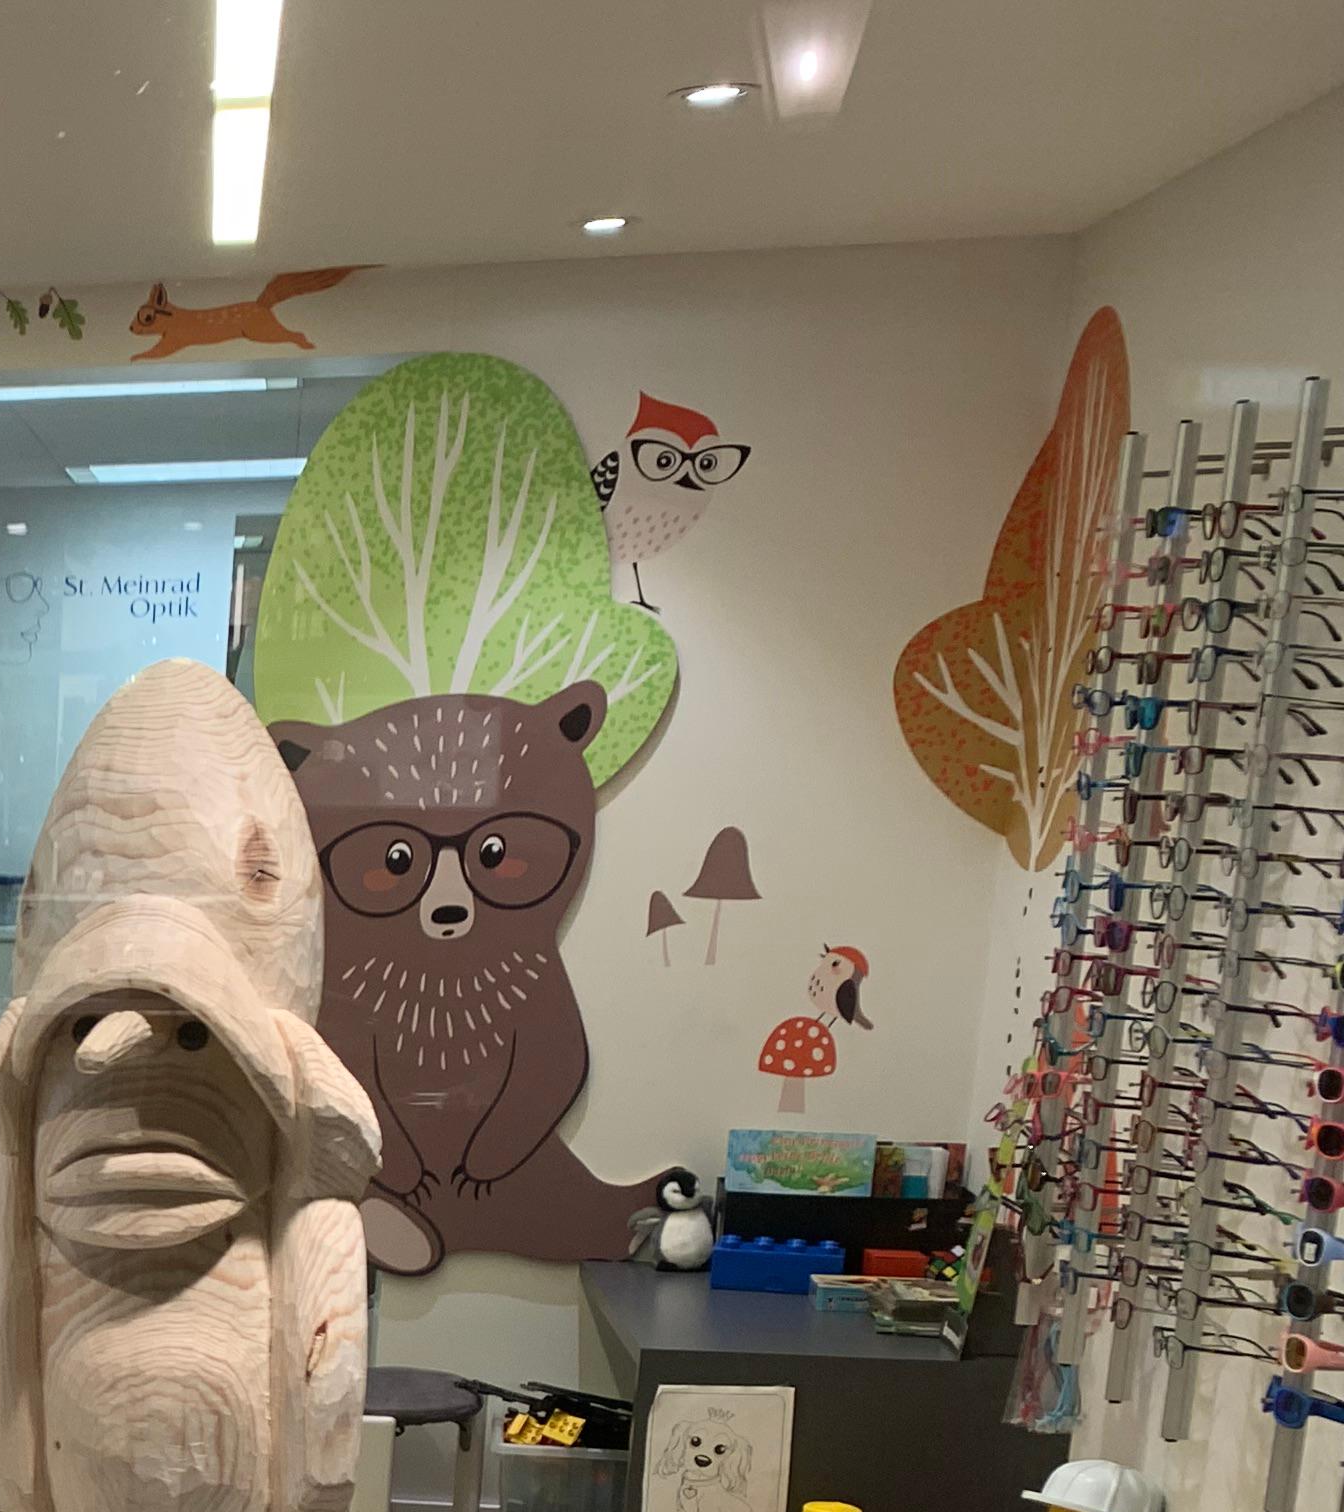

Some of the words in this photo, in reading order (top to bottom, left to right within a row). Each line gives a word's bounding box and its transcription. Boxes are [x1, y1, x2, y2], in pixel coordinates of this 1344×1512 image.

[63, 575, 93, 597] St.
[100, 571, 201, 596] Meinrad
[130, 596, 199, 624] Optik
